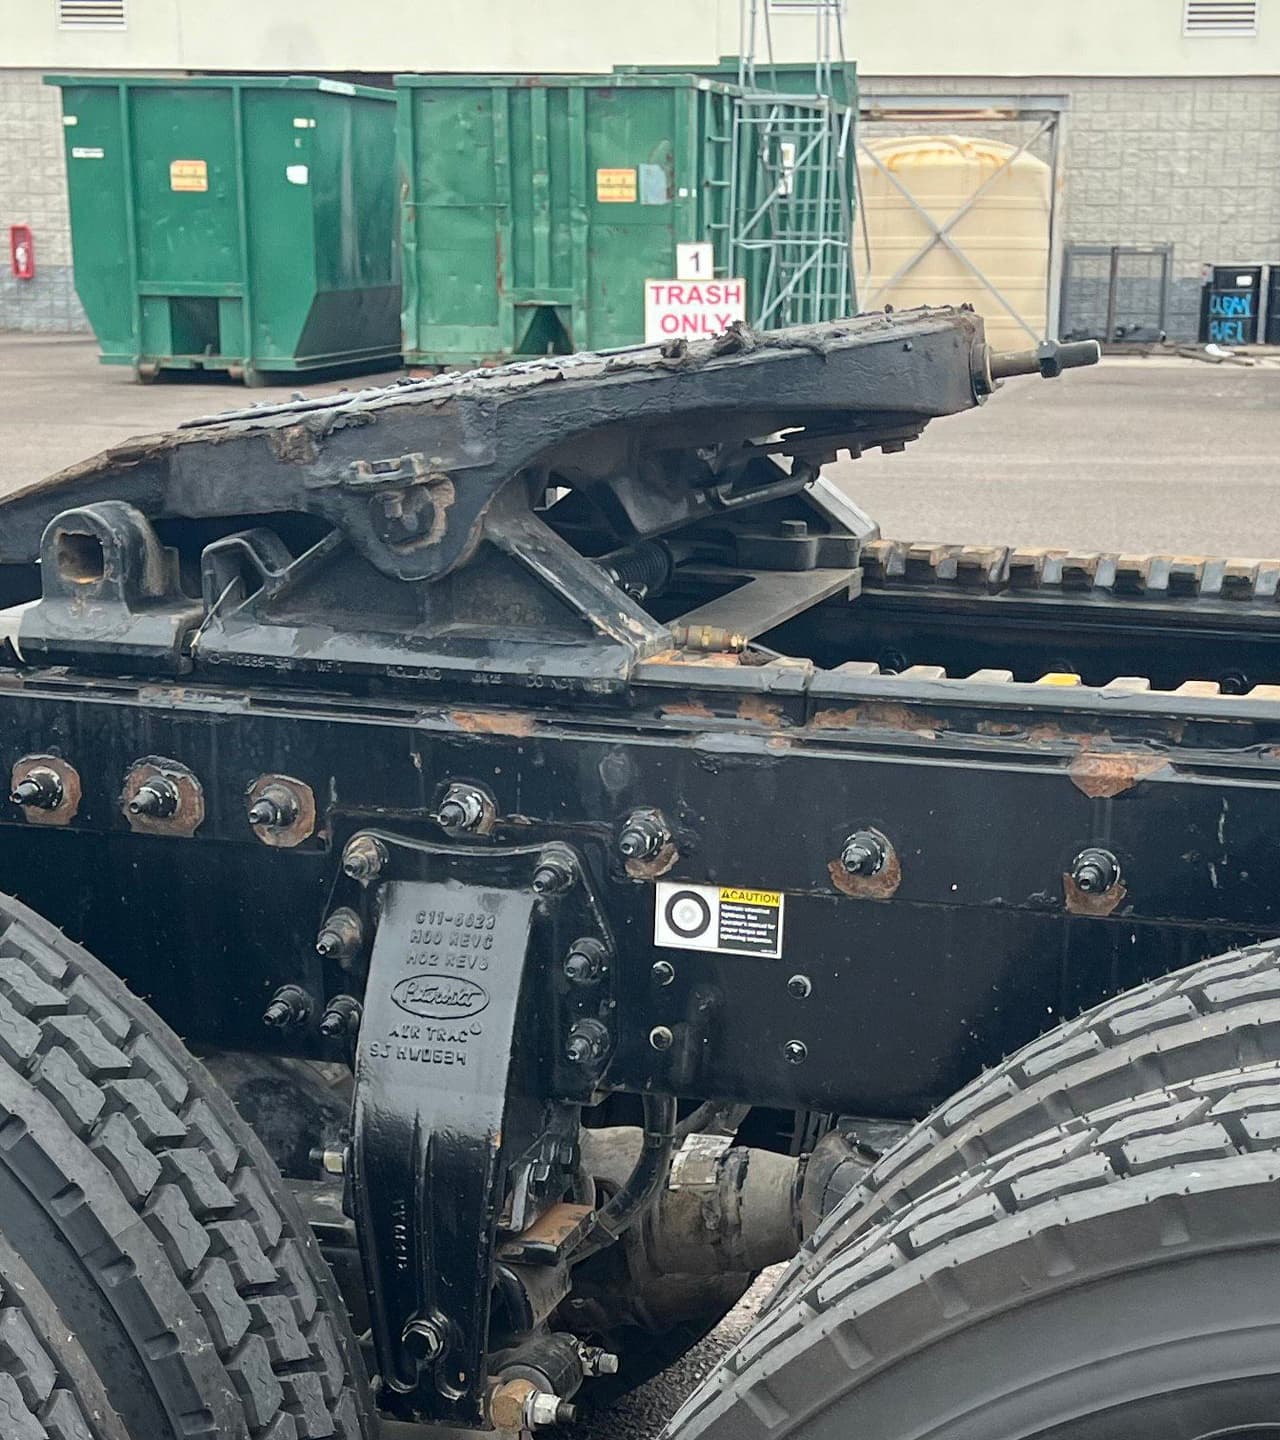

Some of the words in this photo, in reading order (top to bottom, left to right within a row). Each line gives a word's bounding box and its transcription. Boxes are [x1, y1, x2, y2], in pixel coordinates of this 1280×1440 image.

[689, 250, 700, 273] 1
[650, 285, 741, 305] TRASH
[660, 313, 732, 334] ONLY
[729, 890, 780, 905] CAUTION
